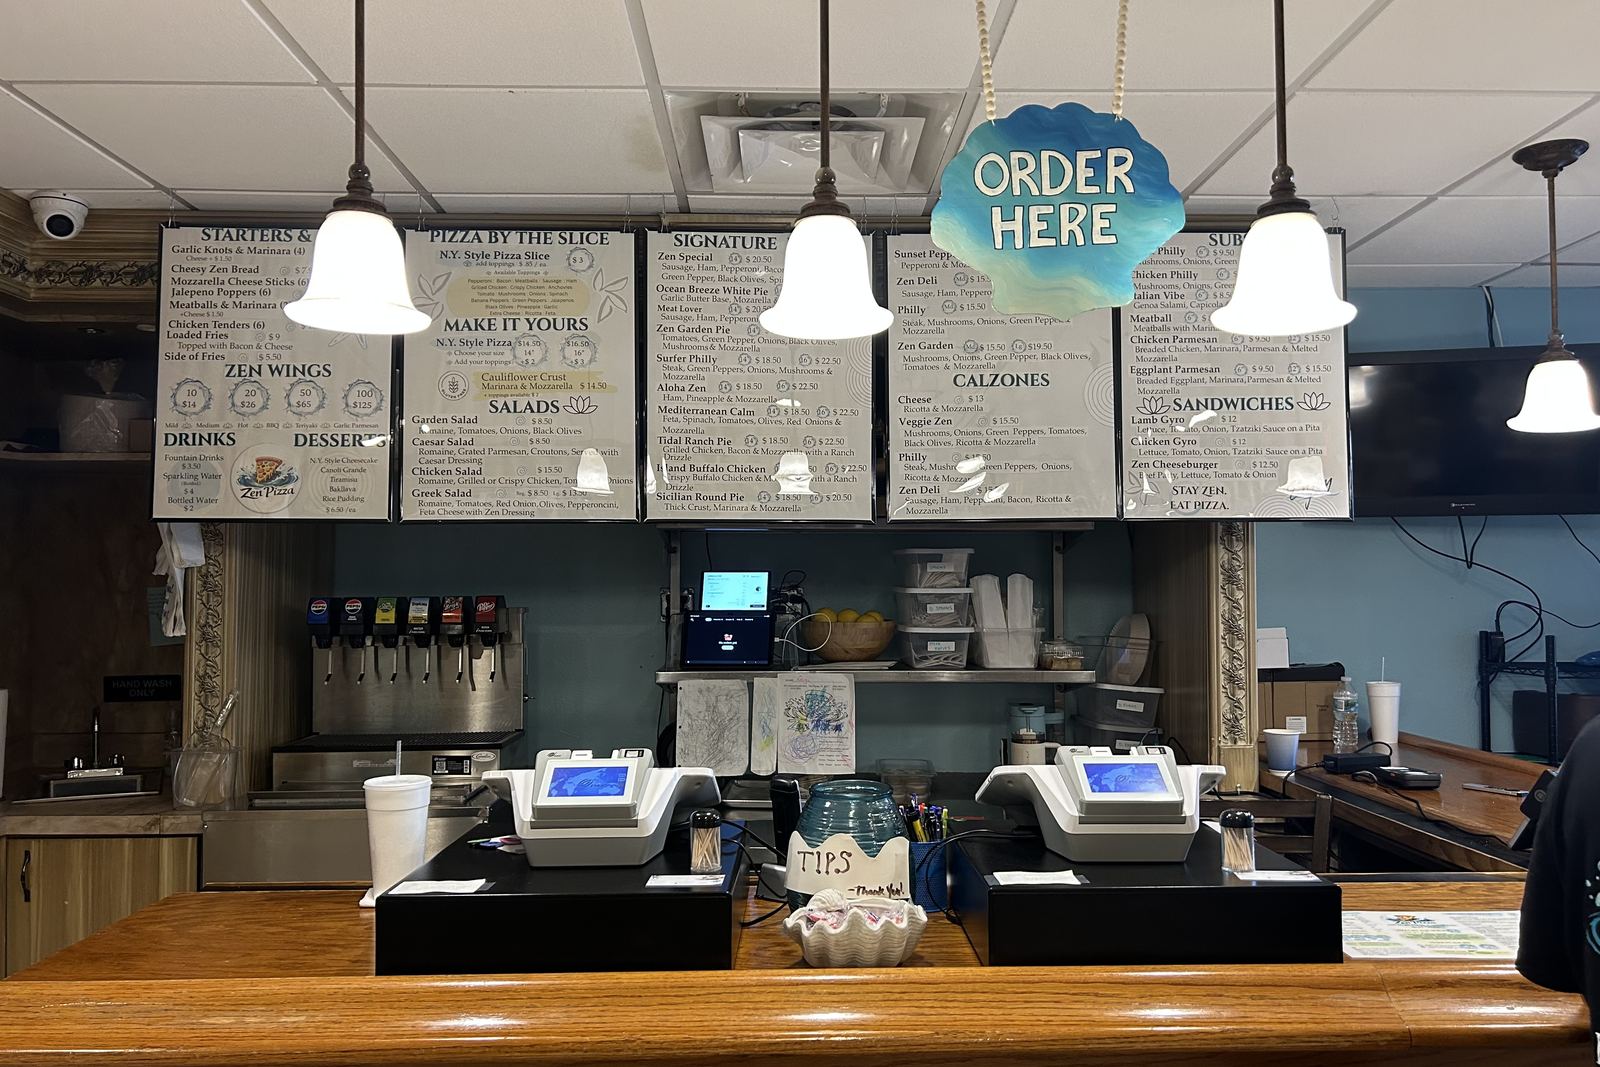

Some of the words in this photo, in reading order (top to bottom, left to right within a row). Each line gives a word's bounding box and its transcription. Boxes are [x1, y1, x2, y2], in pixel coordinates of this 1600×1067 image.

[974, 147, 1135, 197] ORDER
[991, 202, 1118, 249] HERE
[200, 227, 294, 242] STARTERS
[296, 228, 313, 242] &
[428, 229, 484, 243] PIZZA
[487, 230, 516, 243] BY
[518, 232, 553, 244] THE
[558, 232, 609, 245] SLICE
[674, 234, 777, 250] SIGNATURE
[172, 245, 201, 253] Garlic
[204, 246, 232, 254] Knots
[236, 246, 243, 254] &
[1158, 247, 1185, 257] Philly
[440, 251, 460, 259] N.Y.
[464, 251, 490, 262] Style
[494, 251, 521, 259] Pizza
[525, 252, 550, 260] Slice
[658, 252, 675, 260] Zen
[679, 253, 712, 263] Special
[895, 250, 926, 258] Sunset
[929, 250, 955, 262] Pepp
[171, 265, 206, 275] Cheesy
[209, 265, 228, 273] Zen
[232, 265, 259, 273] Bread
[171, 277, 224, 285] Mozzarella
[228, 277, 262, 285] Cheese
[266, 278, 294, 286] Sticks
[918, 276, 937, 284] Deli
[171, 288, 214, 298] Jalepeno
[217, 288, 256, 298] Poppers
[259, 288, 271, 296] (6)
[656, 284, 685, 295] Ocean
[689, 285, 719, 294] Breeze
[723, 287, 751, 295] White
[898, 306, 925, 316] Philly
[1130, 314, 1171, 322] Meatball
[169, 320, 208, 328] Chicken
[212, 321, 250, 329] Tenders
[253, 321, 265, 329] (6)
[444, 318, 497, 331] MAKE
[503, 318, 522, 331] IT
[527, 318, 588, 331] YOURS
[657, 324, 674, 332] Zen
[678, 325, 712, 333] Garden
[716, 326, 730, 334] Pie
[459, 338, 483, 349] Style
[487, 338, 513, 348] Pizza
[898, 342, 915, 350] Zen
[919, 341, 953, 349] Garden
[1131, 335, 1169, 343] Chicken
[1173, 336, 1217, 346] Parmesan
[165, 352, 186, 360] Side
[189, 352, 199, 360] of
[202, 352, 225, 360] Fries
[657, 354, 686, 362] Surfer
[688, 355, 717, 366] Philly
[225, 364, 262, 379] ZEN
[267, 364, 331, 379] WINGS
[1131, 366, 1172, 376] Eggplant
[482, 373, 535, 381] Cauliflower
[536, 373, 566, 381] Crust
[953, 373, 1049, 387] CALZONES
[657, 383, 685, 391] Aloha
[688, 384, 705, 392] Zen
[245, 389, 256, 397] 20
[898, 396, 931, 404] Cheese
[1173, 397, 1294, 411] SANDWICHES
[489, 400, 559, 413] SALADS
[658, 406, 727, 416] Mediterranean
[730, 408, 754, 416] Calm
[932, 405, 939, 414] &
[942, 405, 983, 414] Mozzarella
[412, 415, 448, 423] Garden
[899, 417, 931, 428] Veggie
[934, 417, 952, 425] Zen
[1132, 416, 1157, 424] Lamb
[1161, 416, 1184, 427] Gyro
[164, 432, 235, 446] DRINKS
[294, 433, 386, 447] DESSERTS
[412, 438, 445, 446] Caesar
[447, 438, 473, 446] Salad
[657, 436, 681, 444] Tidal
[685, 437, 714, 447] Ranch
[1173, 437, 1196, 447] Gyro
[199, 454, 224, 463] Drinks
[448, 457, 482, 465] Dressing
[899, 453, 927, 463] Philly
[412, 467, 452, 475] Chicken
[456, 467, 482, 475] Salad
[690, 464, 724, 472] Buffalo
[726, 465, 765, 475] Chicken
[1132, 460, 1149, 468] Zen
[1153, 460, 1218, 472] Cheeseburger
[1252, 461, 1257, 470] $
[240, 486, 264, 499] Zen
[264, 485, 294, 497] Pizza
[412, 489, 442, 497] Greek
[445, 489, 471, 497] Salad
[920, 486, 940, 494] Deli
[1172, 486, 1198, 495] STAY
[1202, 487, 1226, 497] ZEN.
[657, 492, 692, 500] Sicilian
[696, 493, 726, 501] Round
[731, 493, 744, 501] Pie
[1171, 501, 1191, 509] EAT
[1194, 501, 1229, 510] PIZZA.
[113, 680, 140, 688] HAND
[143, 680, 172, 688] WASH
[797, 851, 852, 875] TIPS
